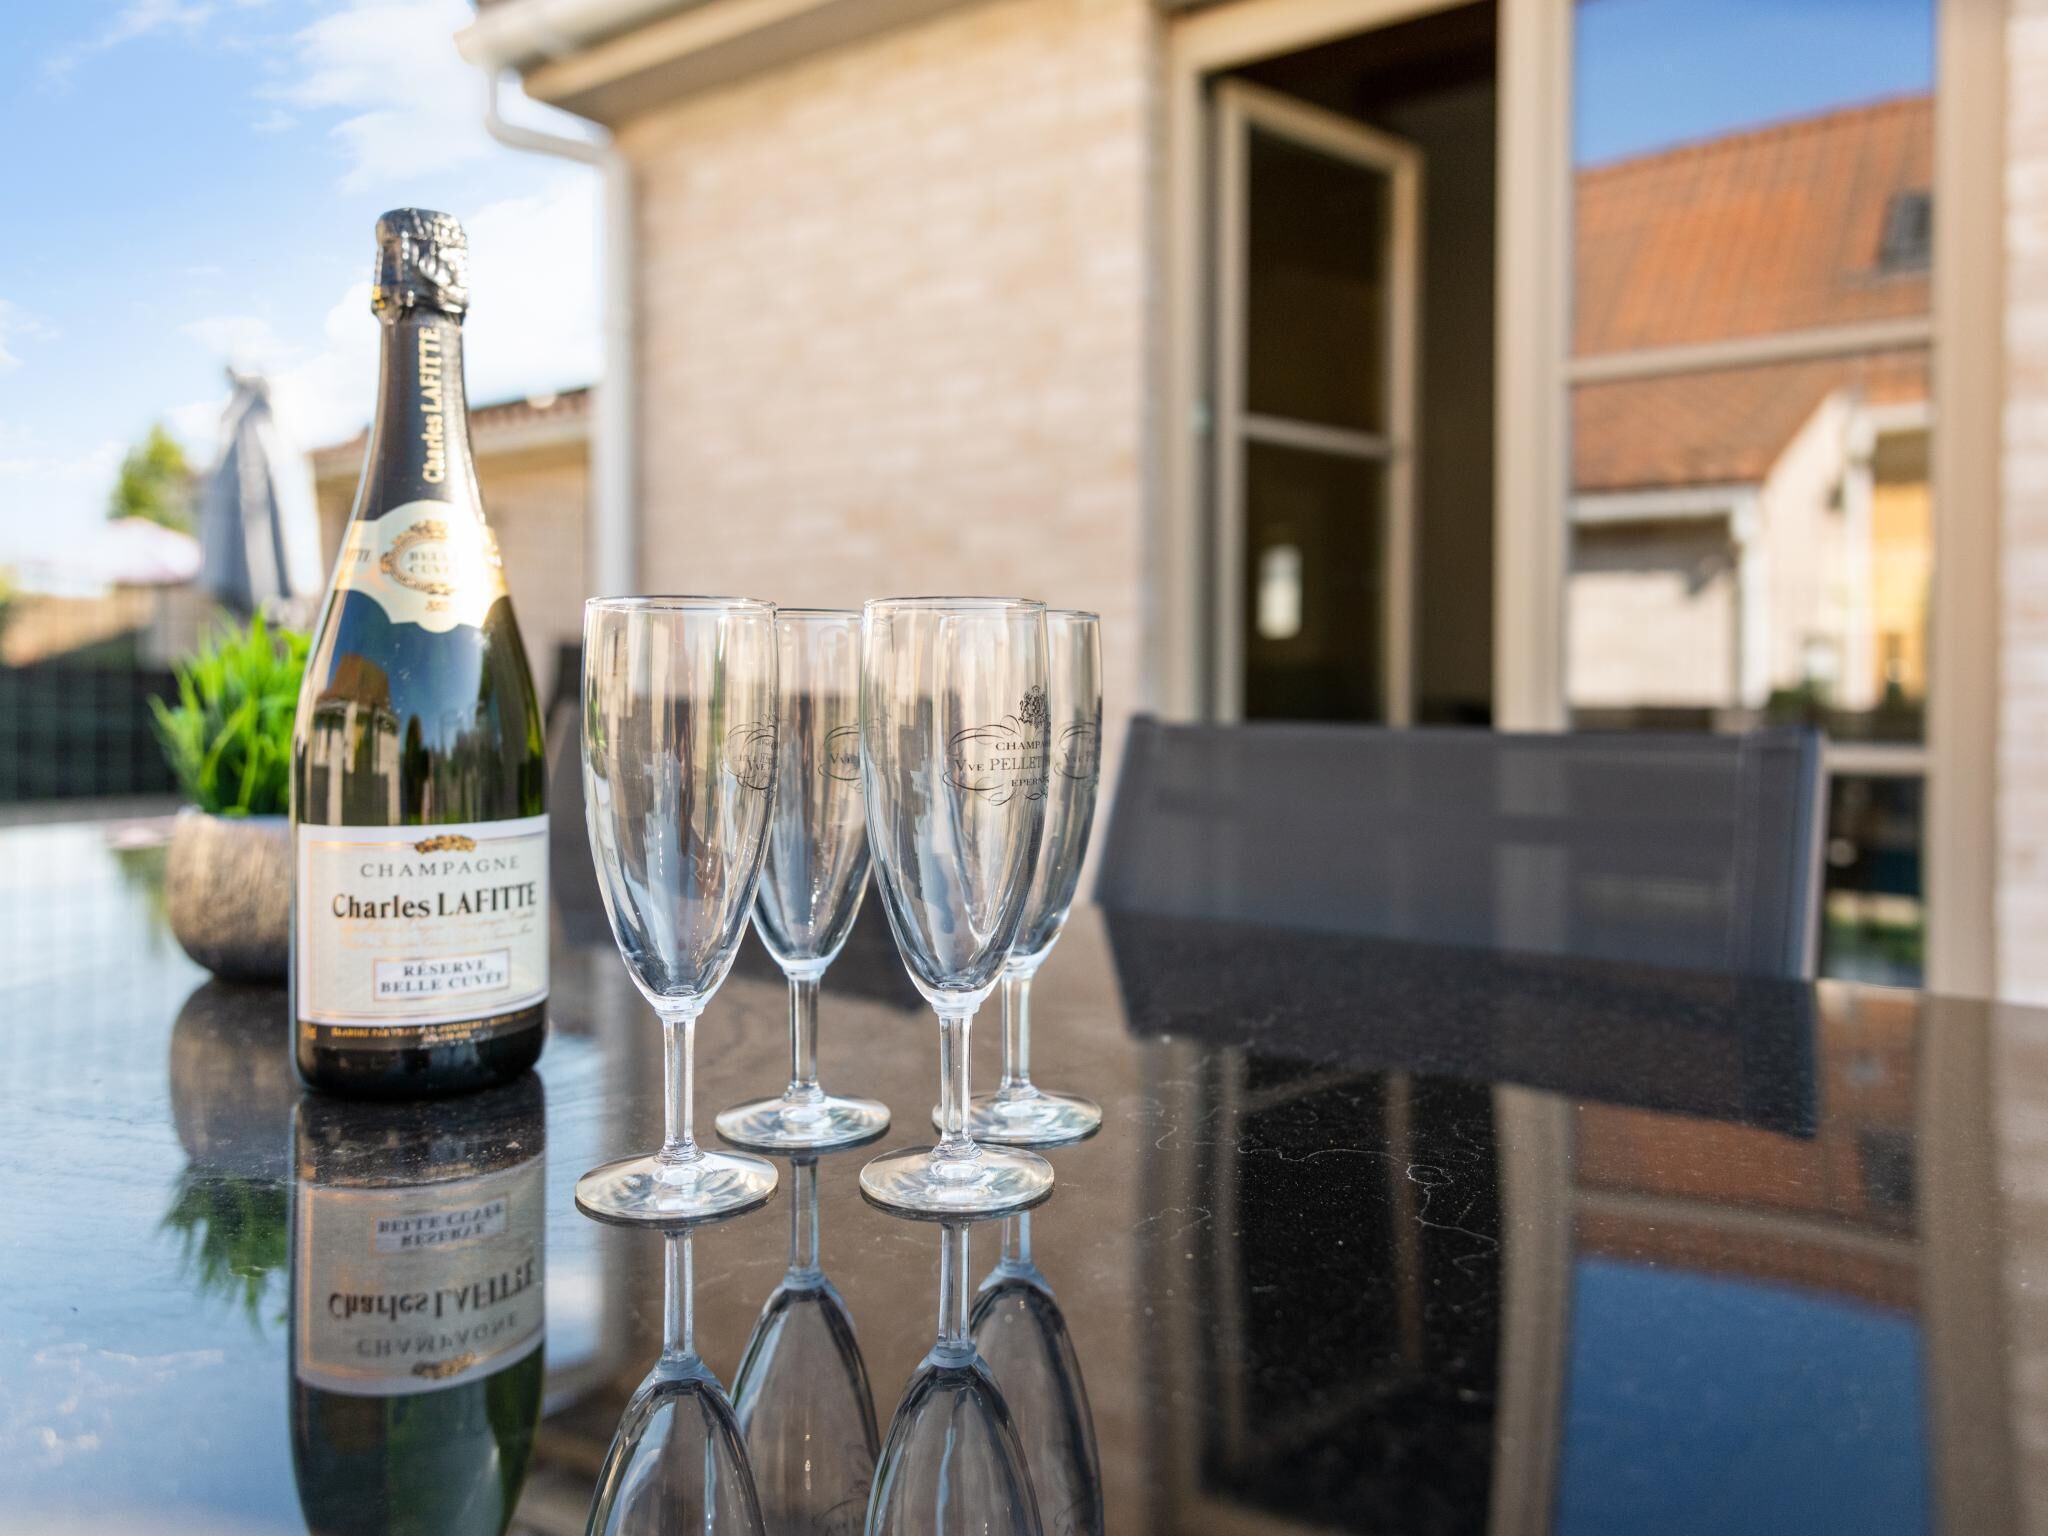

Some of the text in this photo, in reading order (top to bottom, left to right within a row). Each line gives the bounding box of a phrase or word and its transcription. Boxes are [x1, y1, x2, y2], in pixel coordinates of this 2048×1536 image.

[418, 326, 445, 484] Charles LAFITTE
[360, 855, 520, 879] CHAMPAGNE
[333, 881, 537, 919] Charles LAFITTE
[403, 958, 487, 977] RÉSERVE
[380, 978, 443, 994] BELLE
